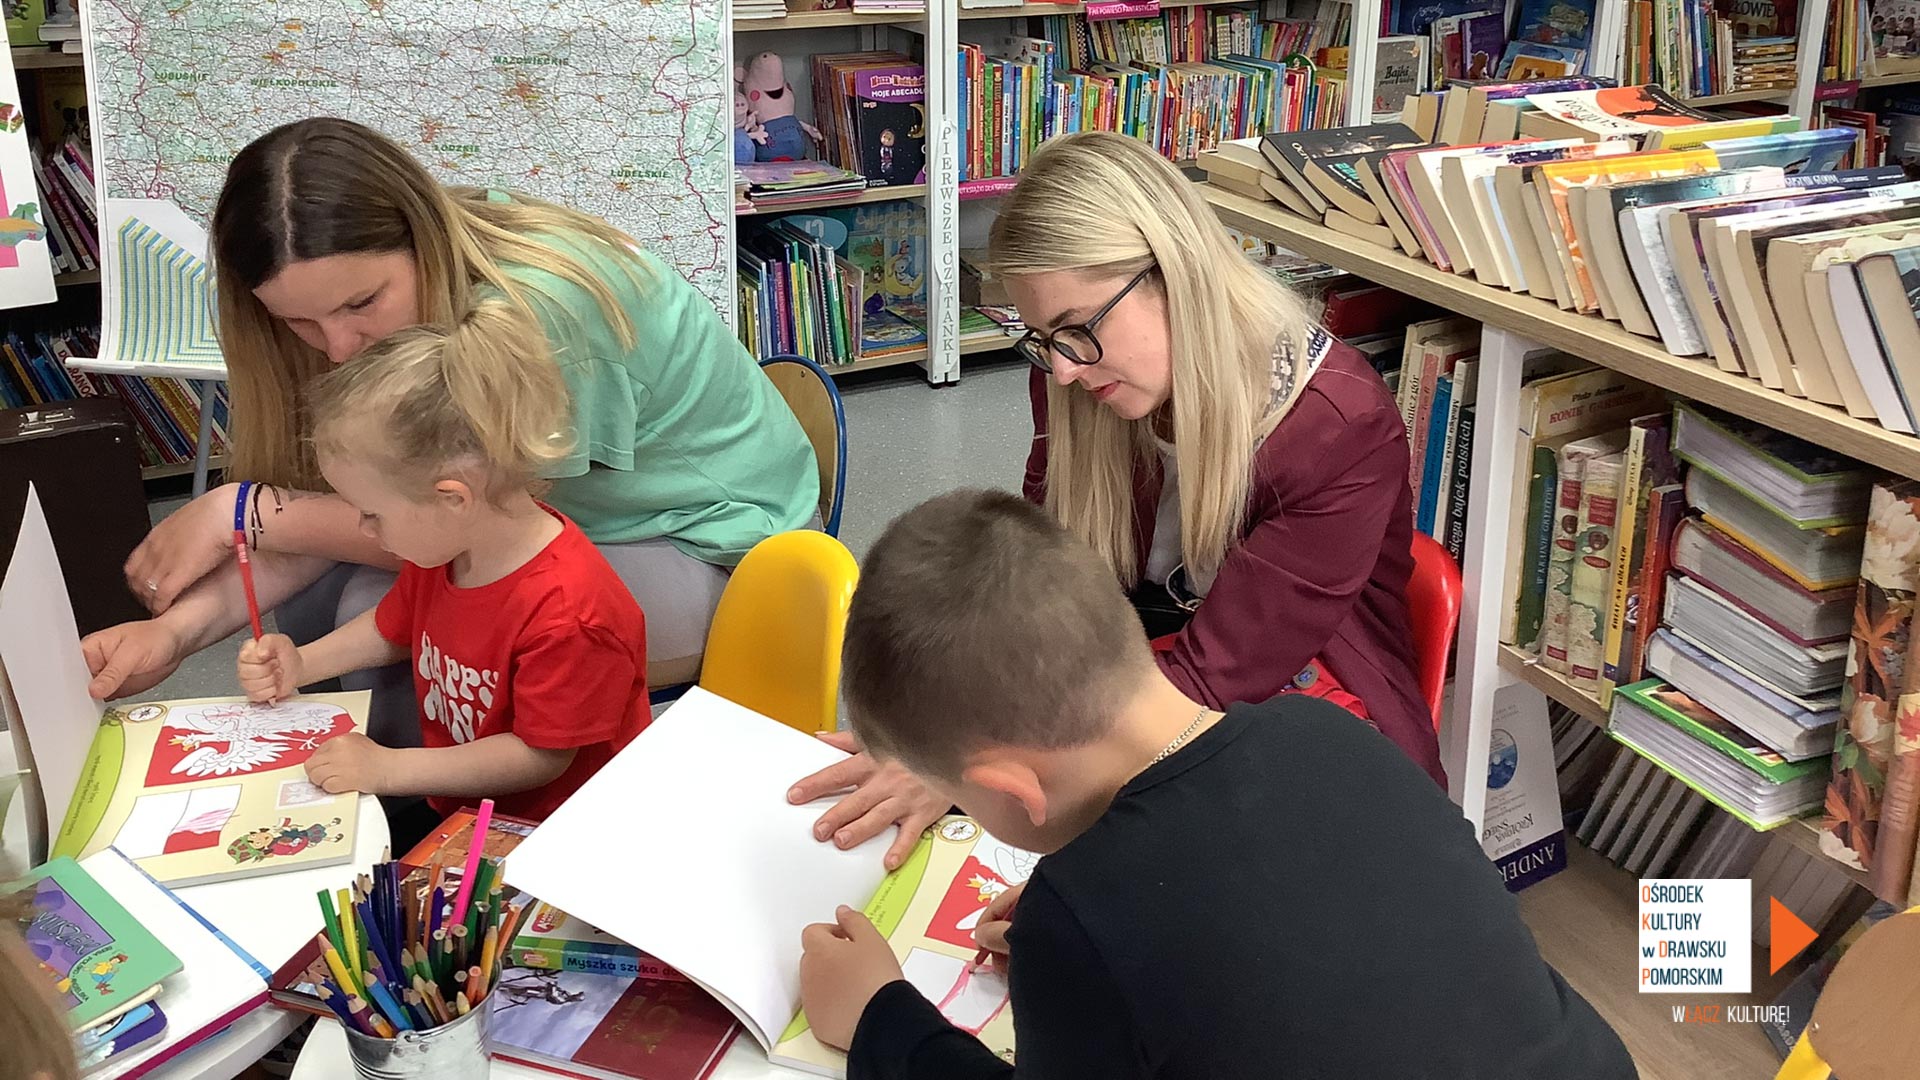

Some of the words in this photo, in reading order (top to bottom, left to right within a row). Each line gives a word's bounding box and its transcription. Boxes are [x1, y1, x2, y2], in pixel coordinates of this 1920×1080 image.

[493, 55, 569, 66] MAZOWIECKIE
[154, 71, 208, 82] LUBUSKIE
[251, 78, 338, 88] WIELKOPOLSKIE
[871, 90, 890, 99] MOJE
[891, 89, 925, 97] ABECADŁ
[610, 169, 669, 179] LUBELSKIE
[940, 126, 955, 244] PIERWSZE
[941, 252, 956, 366] CZYTANKI
[1410, 375, 1420, 395] gór
[1449, 399, 1460, 433] Mitologia
[1457, 420, 1472, 480] polskich
[1452, 481, 1466, 517] bajek
[418, 630, 500, 709] HAPPY
[424, 682, 487, 744] MIN
[567, 957, 616, 975] Myszka
[620, 962, 658, 976] szuka
